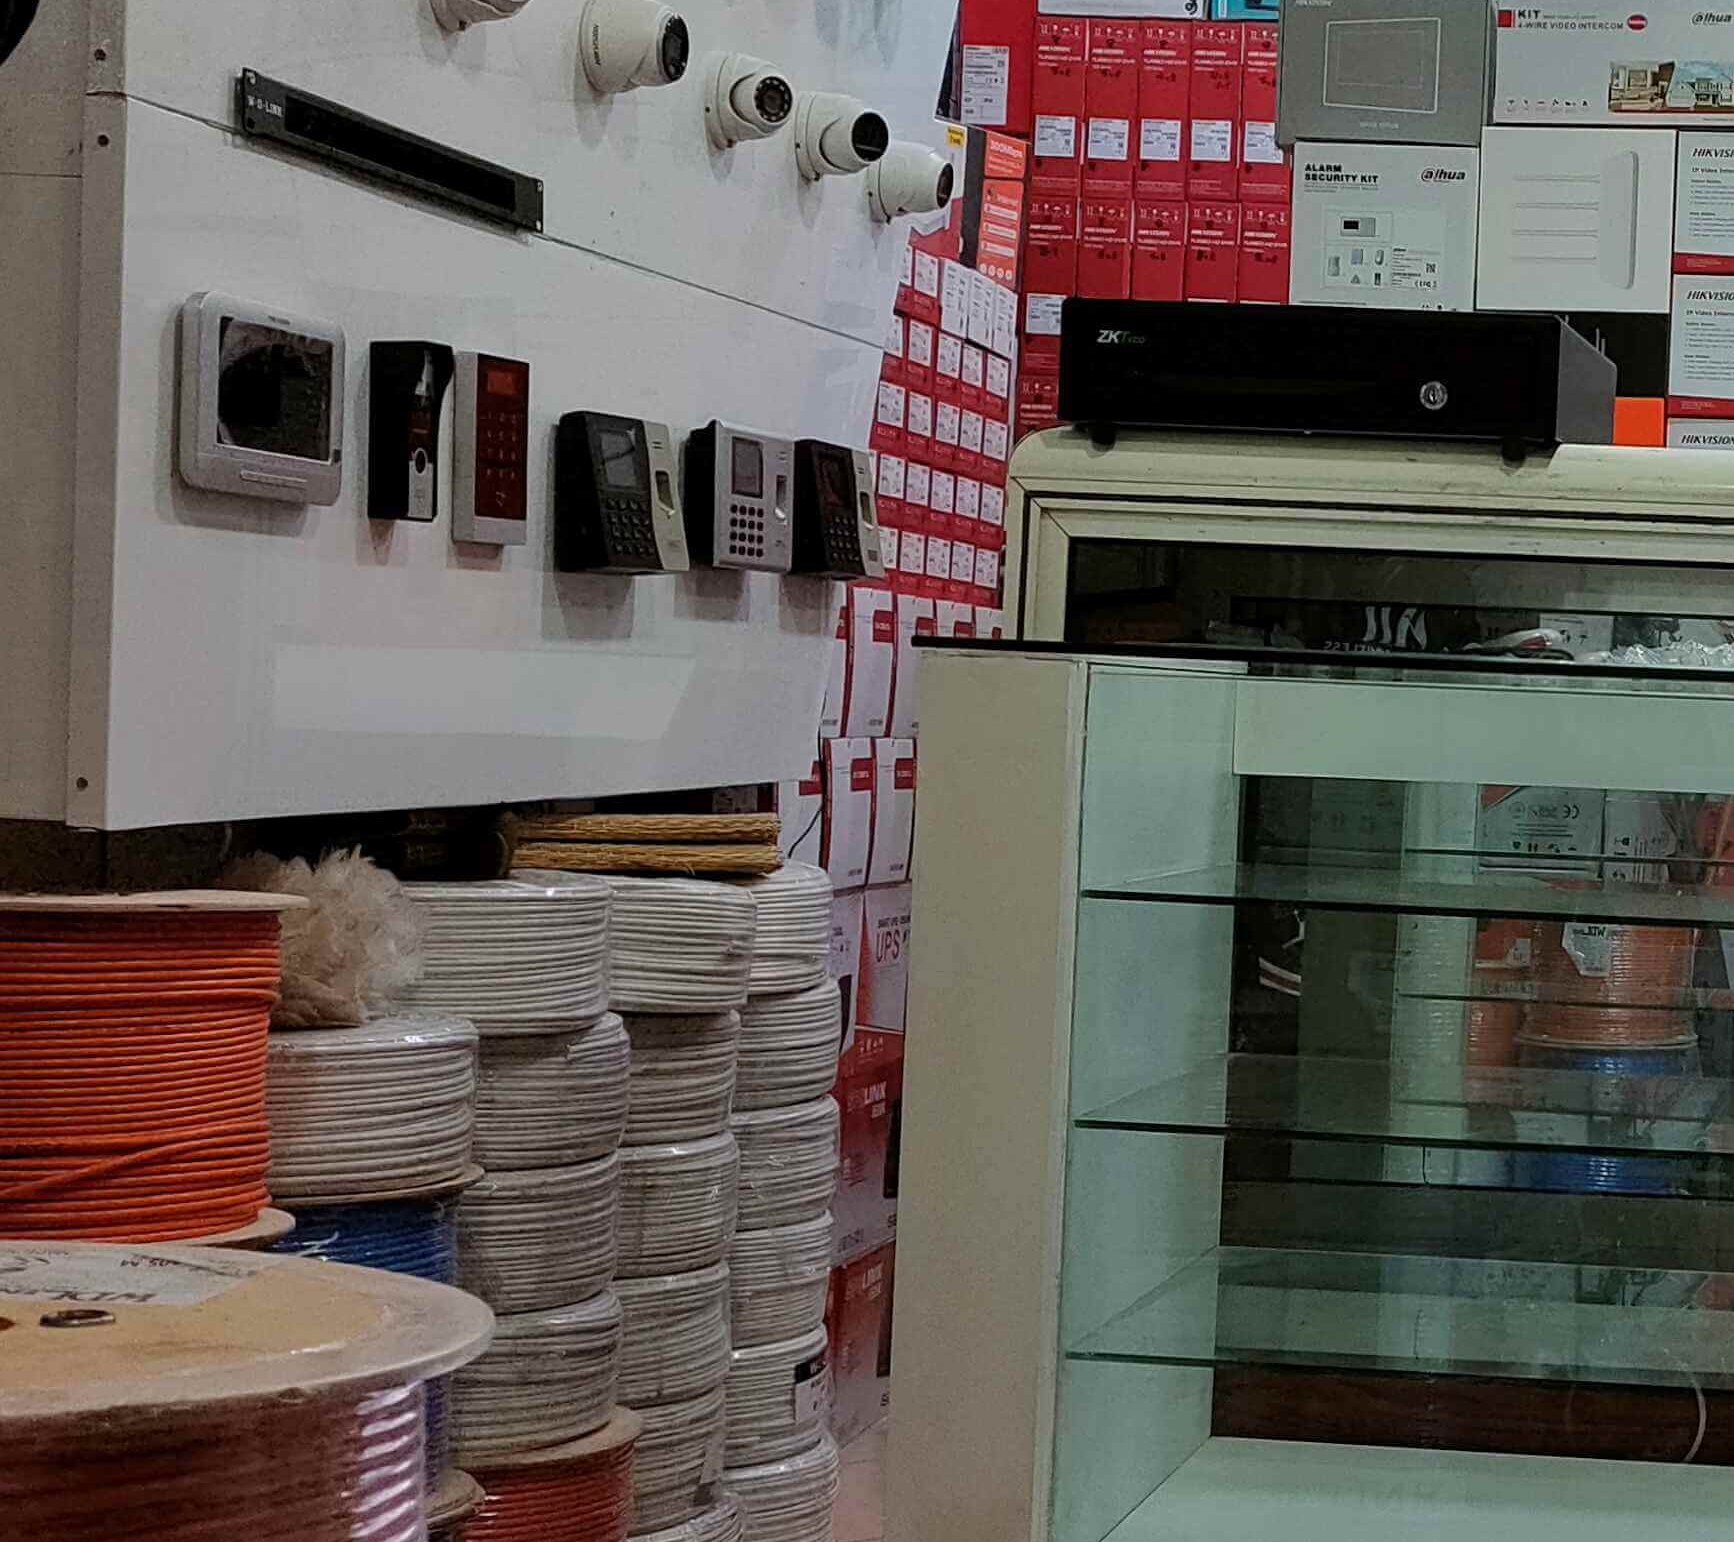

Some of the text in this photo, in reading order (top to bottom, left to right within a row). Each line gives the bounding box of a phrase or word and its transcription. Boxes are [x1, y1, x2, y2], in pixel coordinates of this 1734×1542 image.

[1517, 9, 1542, 20] KIT
[1550, 21, 1577, 30] VIDEO
[1578, 21, 1625, 31] INTERCOM
[1304, 163, 1343, 173] ALARM
[1304, 172, 1379, 184] SECURITY KIT
[875, 929, 900, 962] UPS
